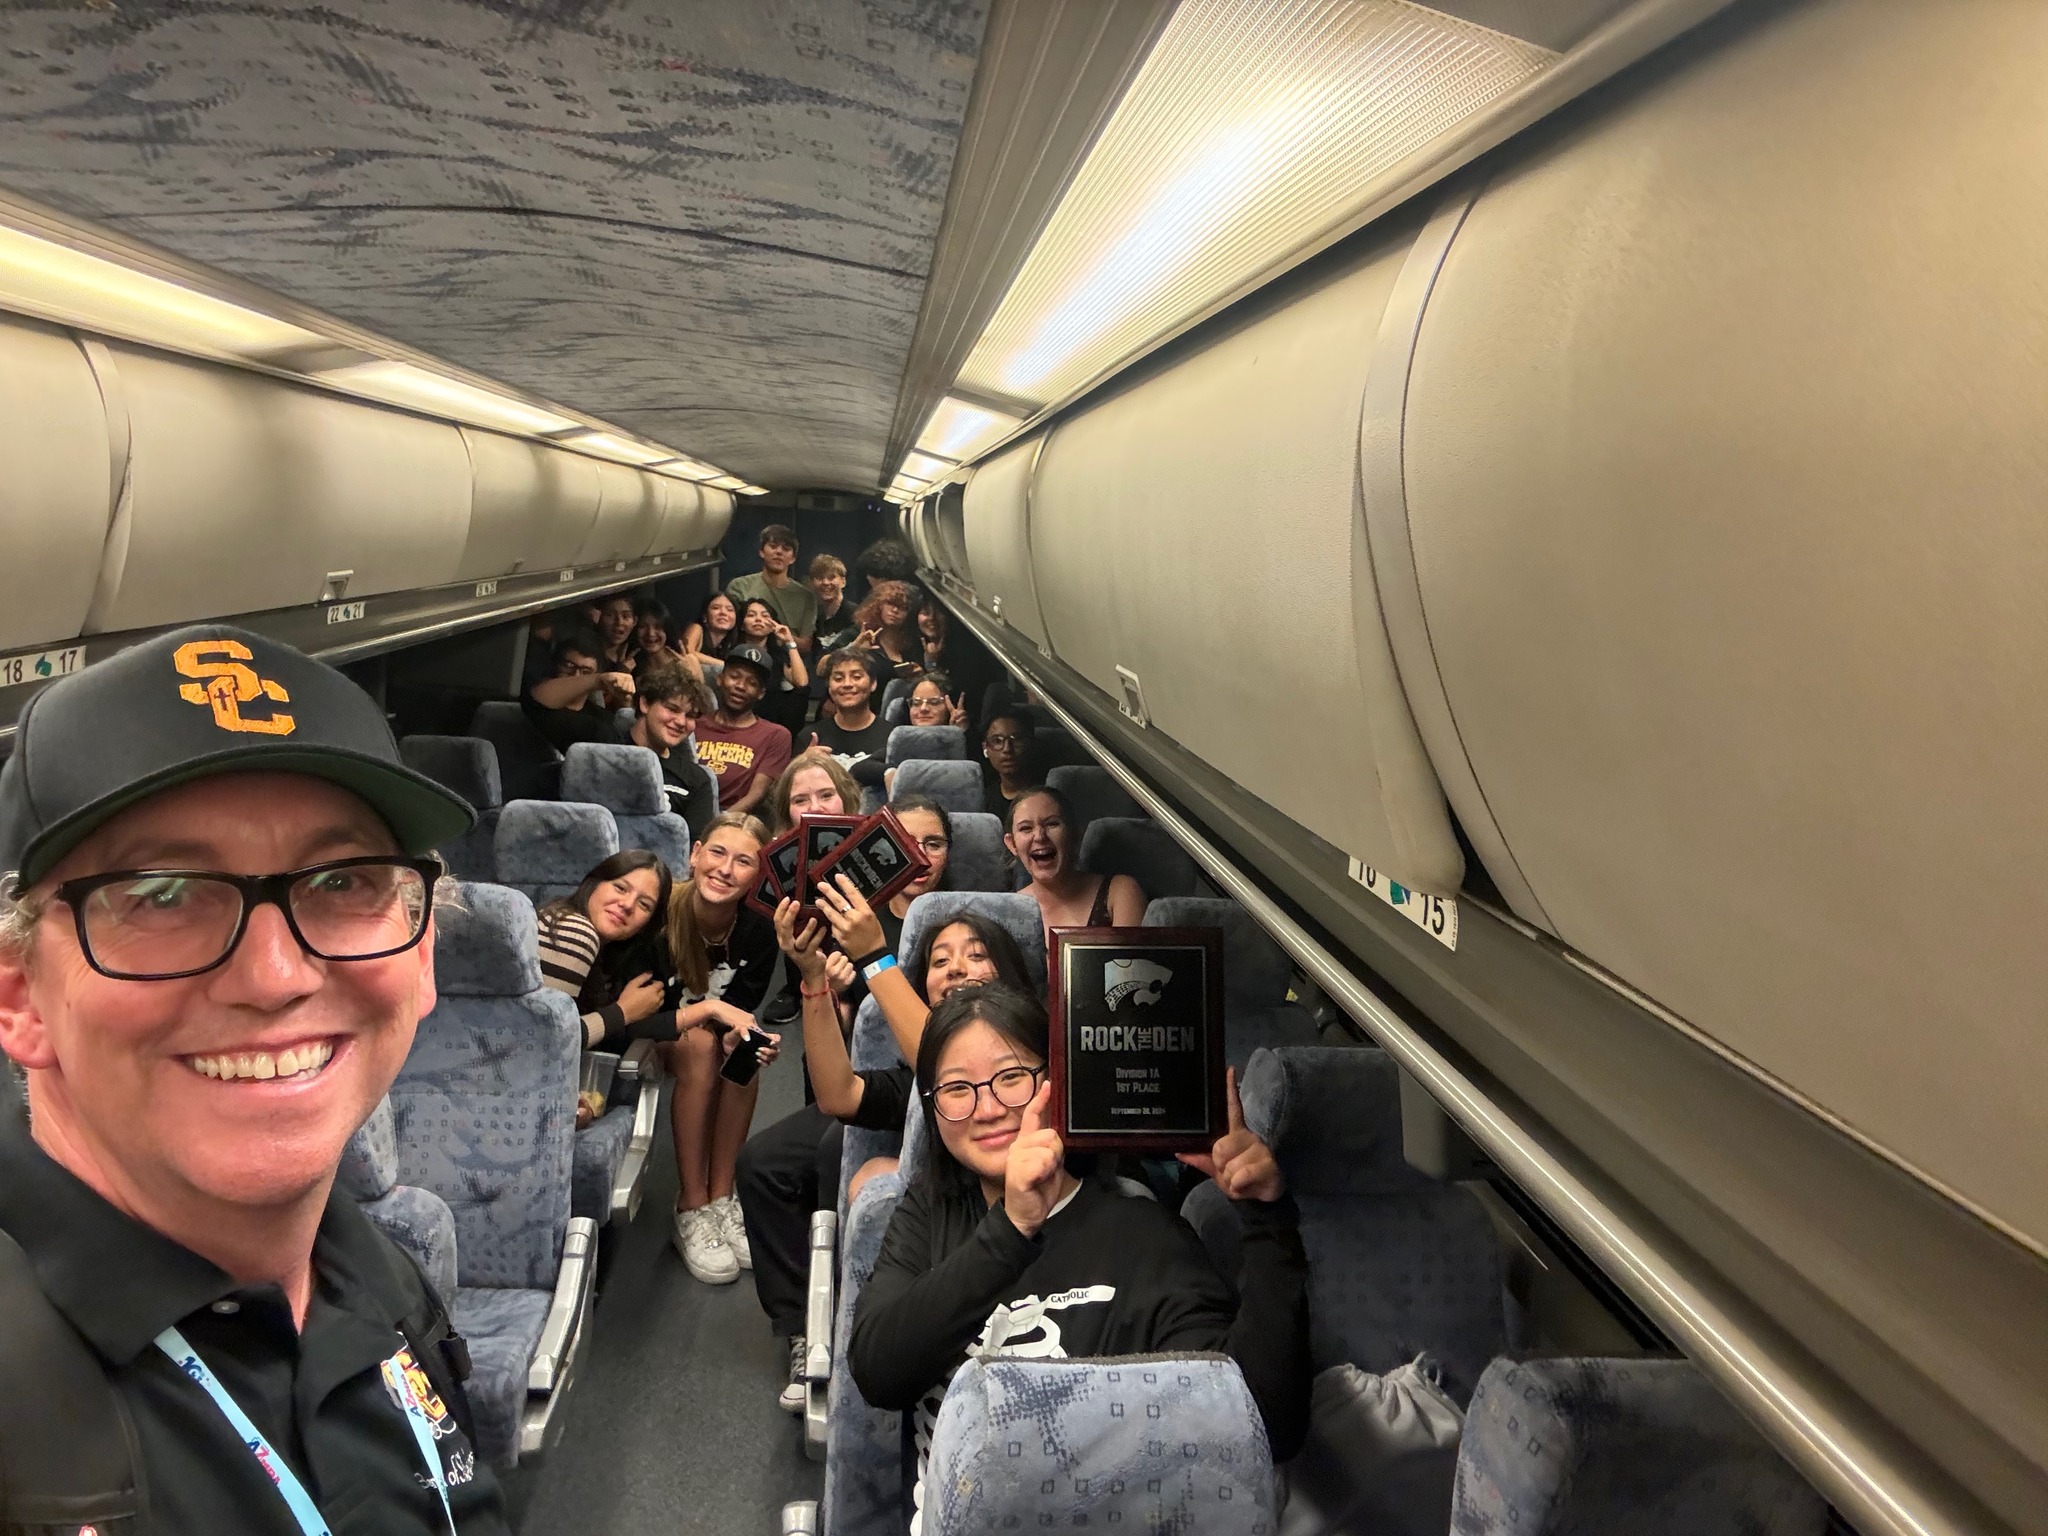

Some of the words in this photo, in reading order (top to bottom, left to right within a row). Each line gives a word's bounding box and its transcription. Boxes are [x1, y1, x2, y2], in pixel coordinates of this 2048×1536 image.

[3, 659, 23, 685] 18
[59, 649, 78, 674] 17
[173, 640, 296, 735] SC
[1420, 893, 1445, 935] 15
[1080, 1025, 1138, 1052] ROCK
[1137, 1026, 1152, 1051] THE
[1152, 1026, 1195, 1052] DEN
